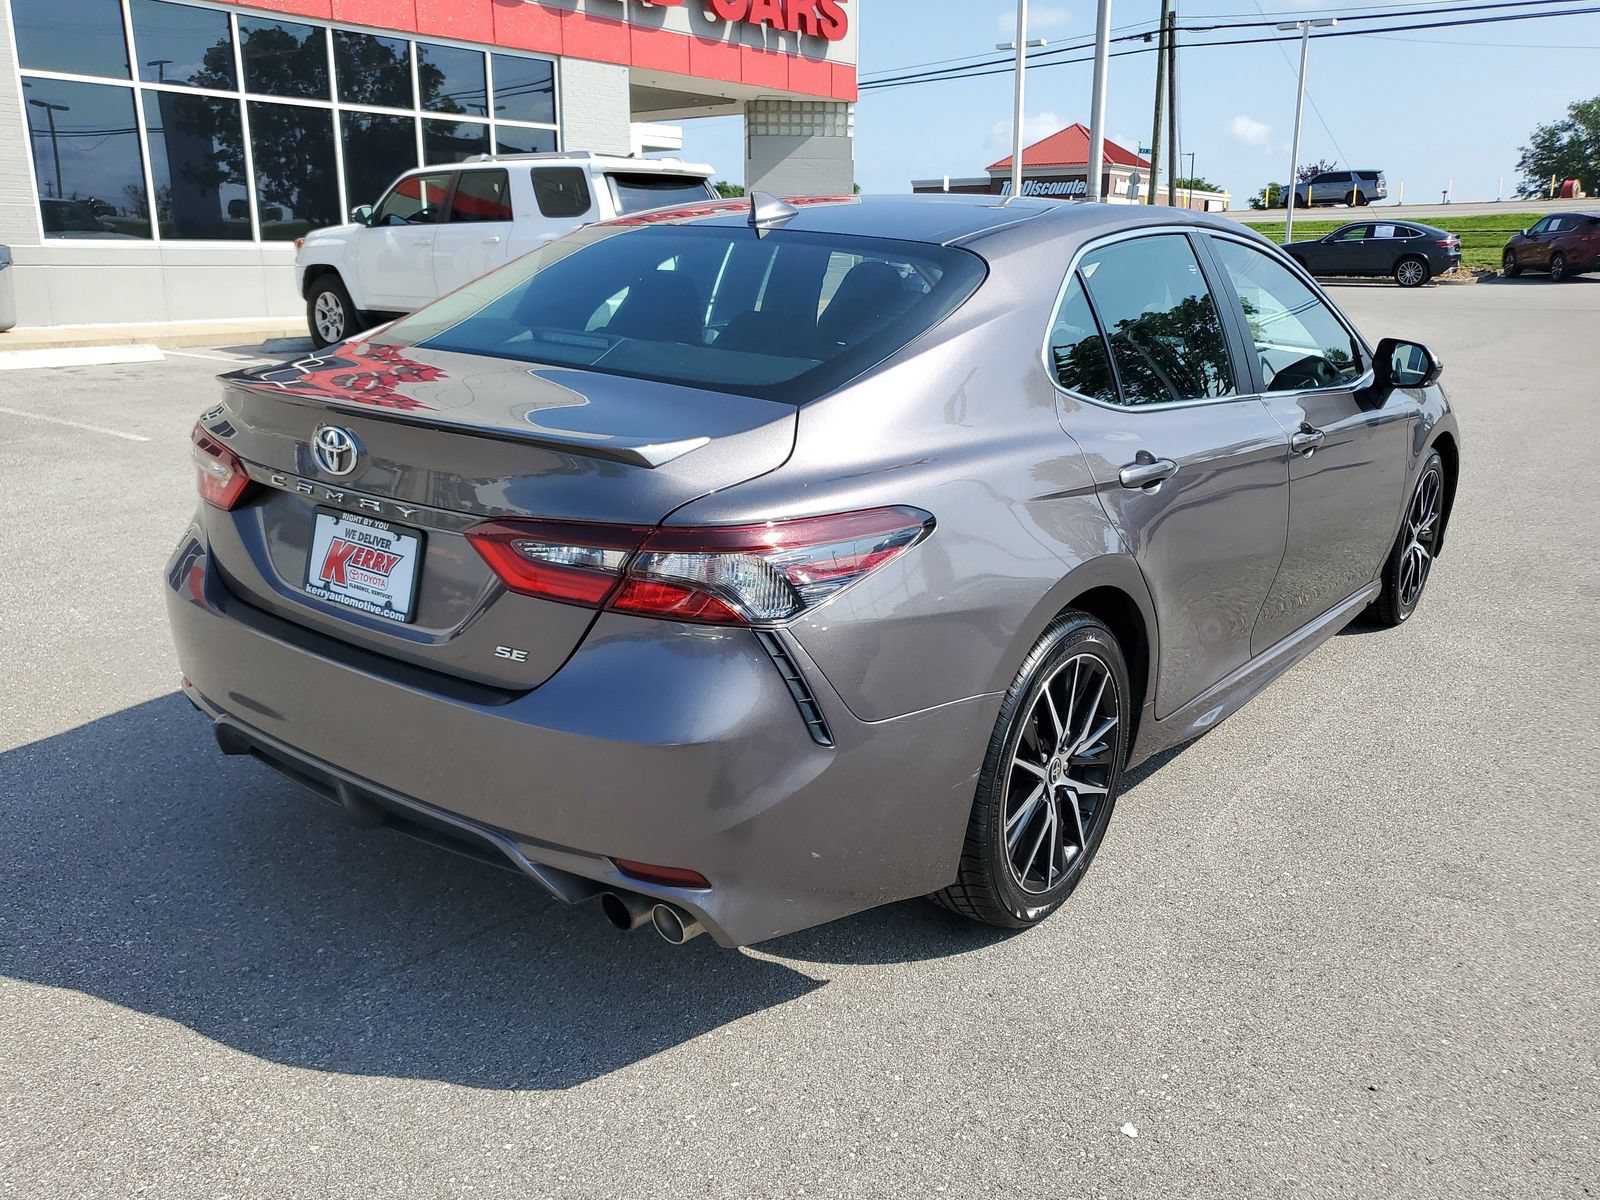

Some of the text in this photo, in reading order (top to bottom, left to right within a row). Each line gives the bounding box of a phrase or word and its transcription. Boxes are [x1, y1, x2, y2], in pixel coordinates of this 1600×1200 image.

[710, 0, 848, 41] CARS
[271, 475, 420, 518] CAMRY
[342, 512, 390, 530] RIGHT BY YOU
[344, 528, 392, 550] WE DELIVER
[320, 537, 402, 587] KERRY
[360, 573, 386, 588] TOYOTA
[306, 583, 405, 622] kerryautomotive.com
[494, 645, 530, 662] SE
